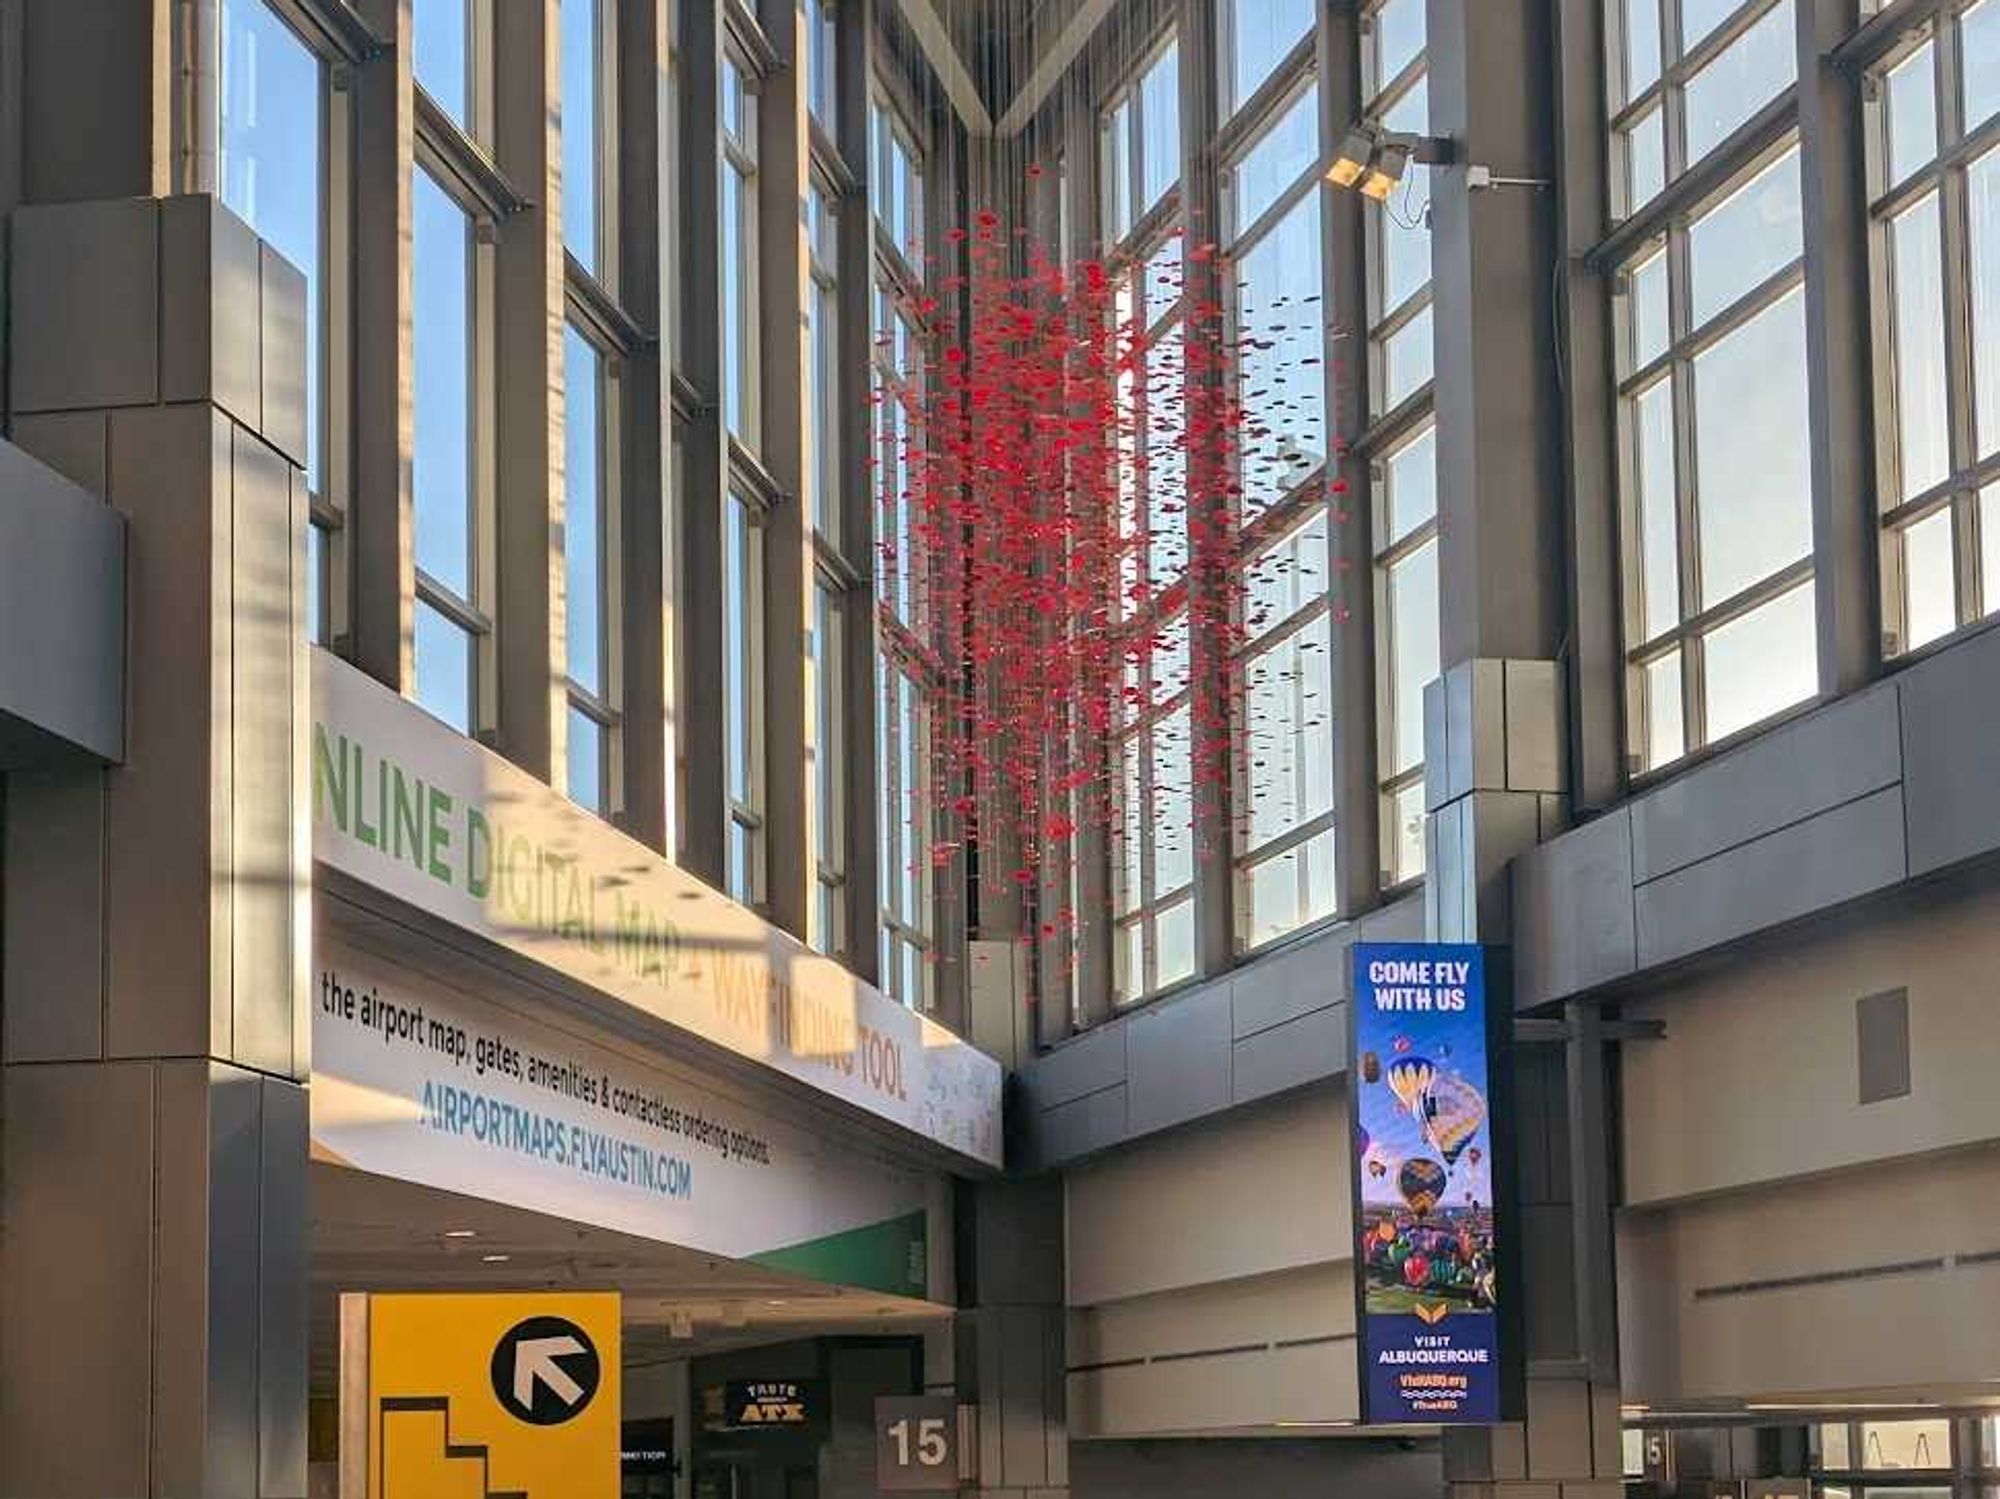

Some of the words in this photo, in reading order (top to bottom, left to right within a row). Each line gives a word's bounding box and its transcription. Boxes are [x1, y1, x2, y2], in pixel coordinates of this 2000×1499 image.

[467, 806, 605, 956] DIGITAL
[858, 1025, 907, 1102] TOOL
[1369, 961, 1431, 984] COME
[1435, 961, 1470, 985] FLY
[1375, 987, 1432, 1011] WITH
[1435, 989, 1466, 1011] US
[322, 971, 355, 1020] the
[361, 987, 424, 1045] airport
[429, 1019, 472, 1067] map,
[476, 1034, 523, 1081] gates,
[528, 1055, 598, 1105] amenities
[602, 1074, 609, 1109] &
[613, 1083, 682, 1135] contactless
[683, 1108, 728, 1159] ordering
[419, 1080, 692, 1199] AIRPORTMAPS.FLYAUSTIN.COM
[1414, 1335, 1451, 1347] VISIT
[1379, 1349, 1489, 1363] ALBUQUERQUE
[740, 1403, 804, 1421] ATX
[888, 1418, 948, 1466] 15
